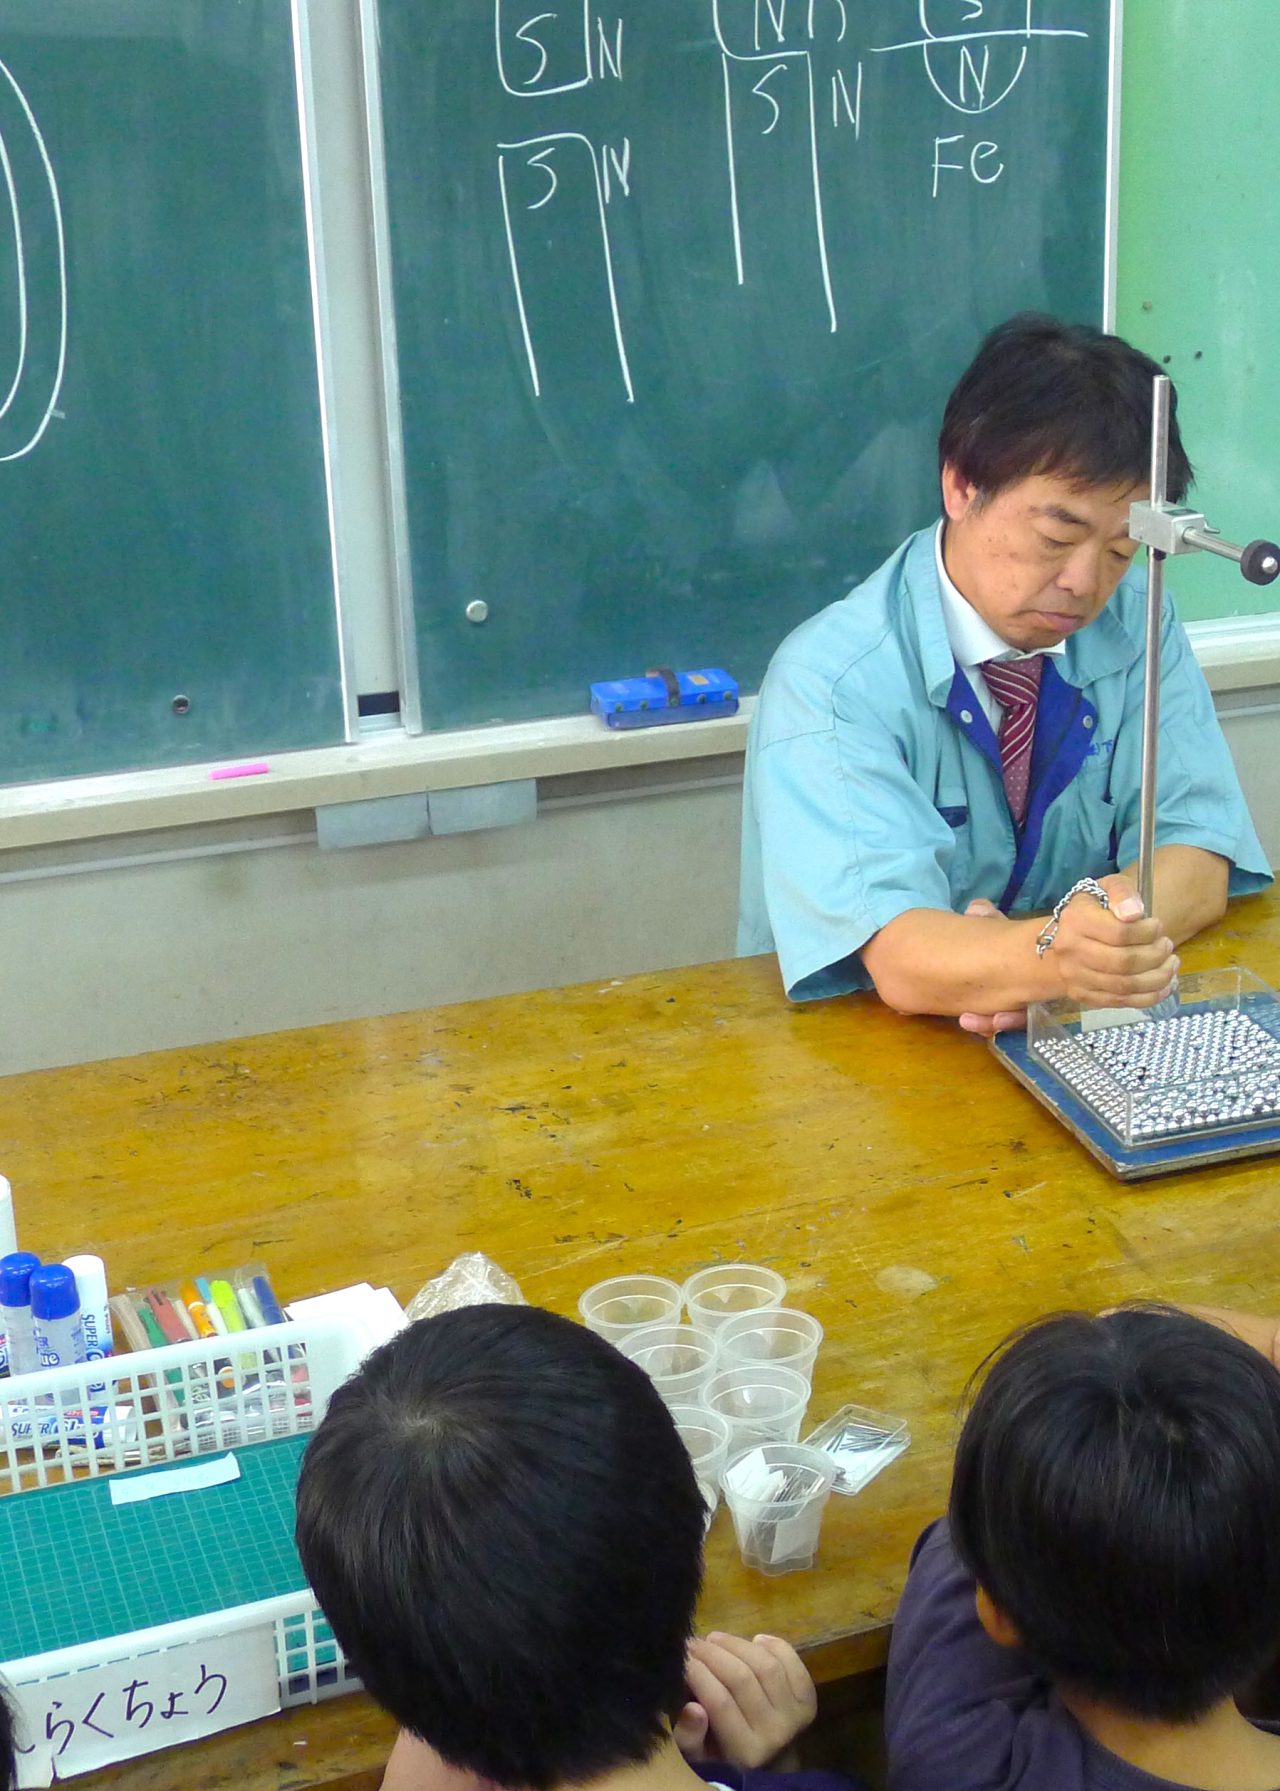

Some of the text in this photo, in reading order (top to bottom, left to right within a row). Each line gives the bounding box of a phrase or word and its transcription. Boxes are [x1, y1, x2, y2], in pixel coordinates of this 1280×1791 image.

[515, 12, 623, 85] S N
[754, 0, 786, 51] N
[752, 61, 863, 140] S N
[959, 44, 989, 110] N
[526, 136, 630, 210] S N
[931, 133, 1004, 198] Fe
[81, 1314, 99, 1347] SUPER
[11, 1422, 50, 1438] SUR
